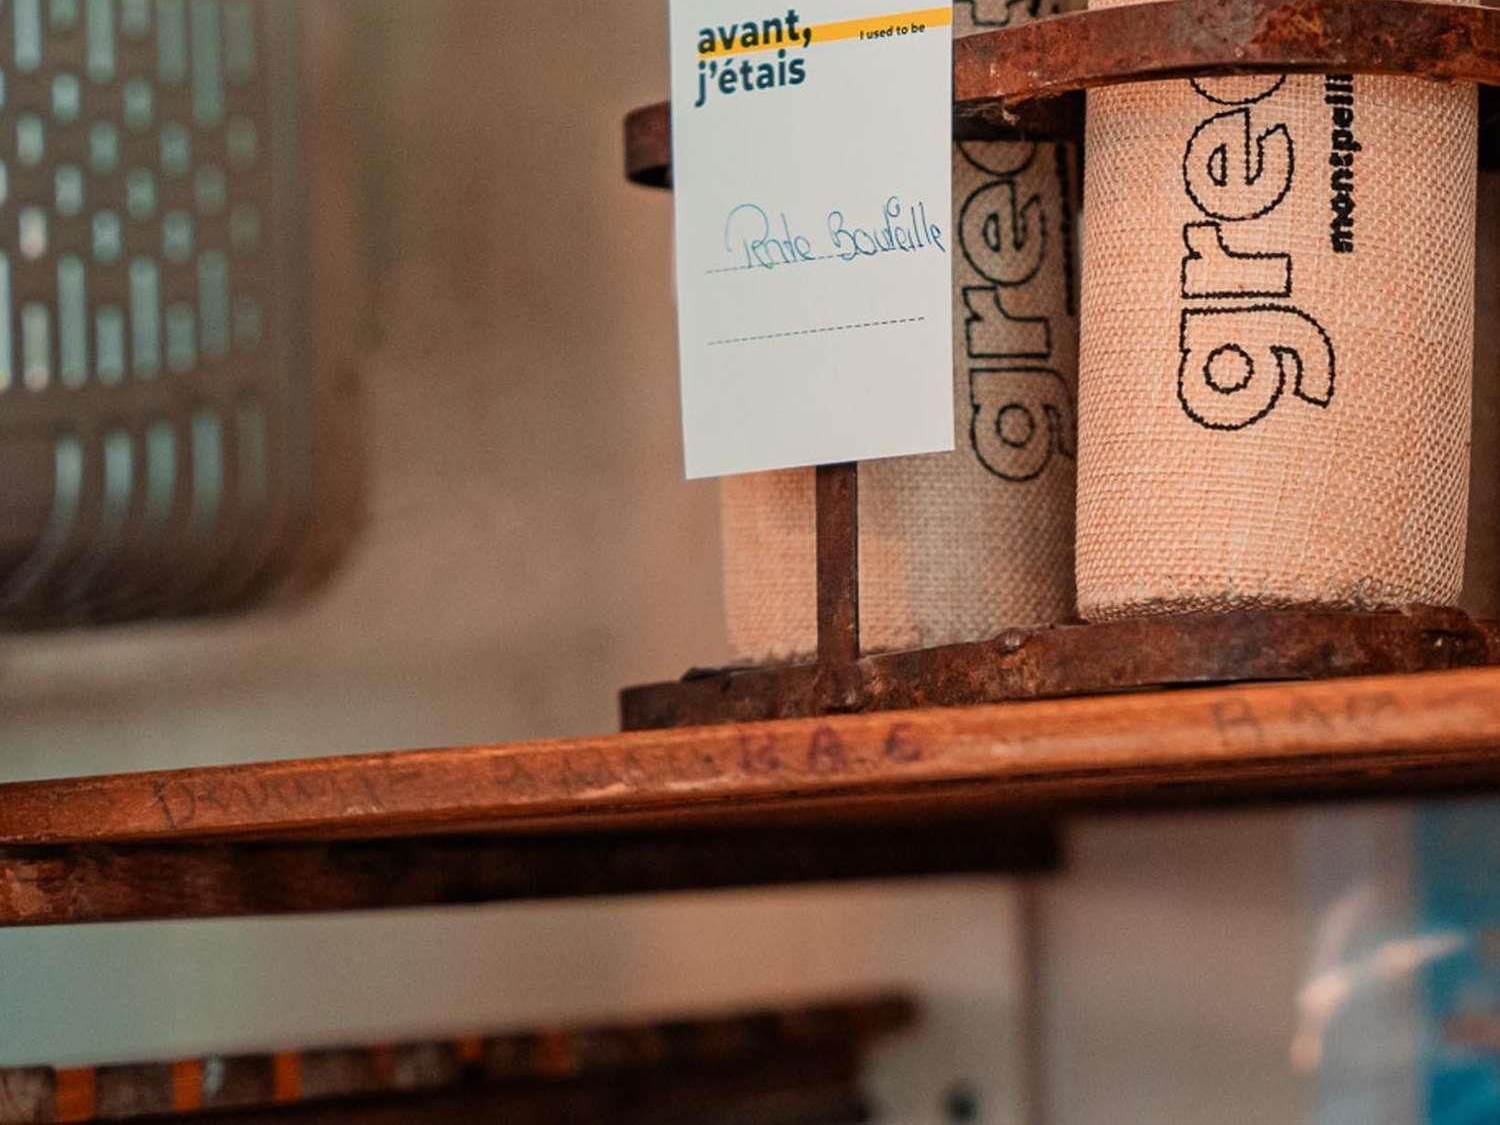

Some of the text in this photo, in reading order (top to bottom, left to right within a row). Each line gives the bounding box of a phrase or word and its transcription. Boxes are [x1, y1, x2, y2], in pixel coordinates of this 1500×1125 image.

[697, 9, 812, 54] avant,
[866, 25, 893, 40] used
[896, 25, 908, 36] to
[910, 21, 926, 33] be
[695, 48, 807, 107] j'étais
